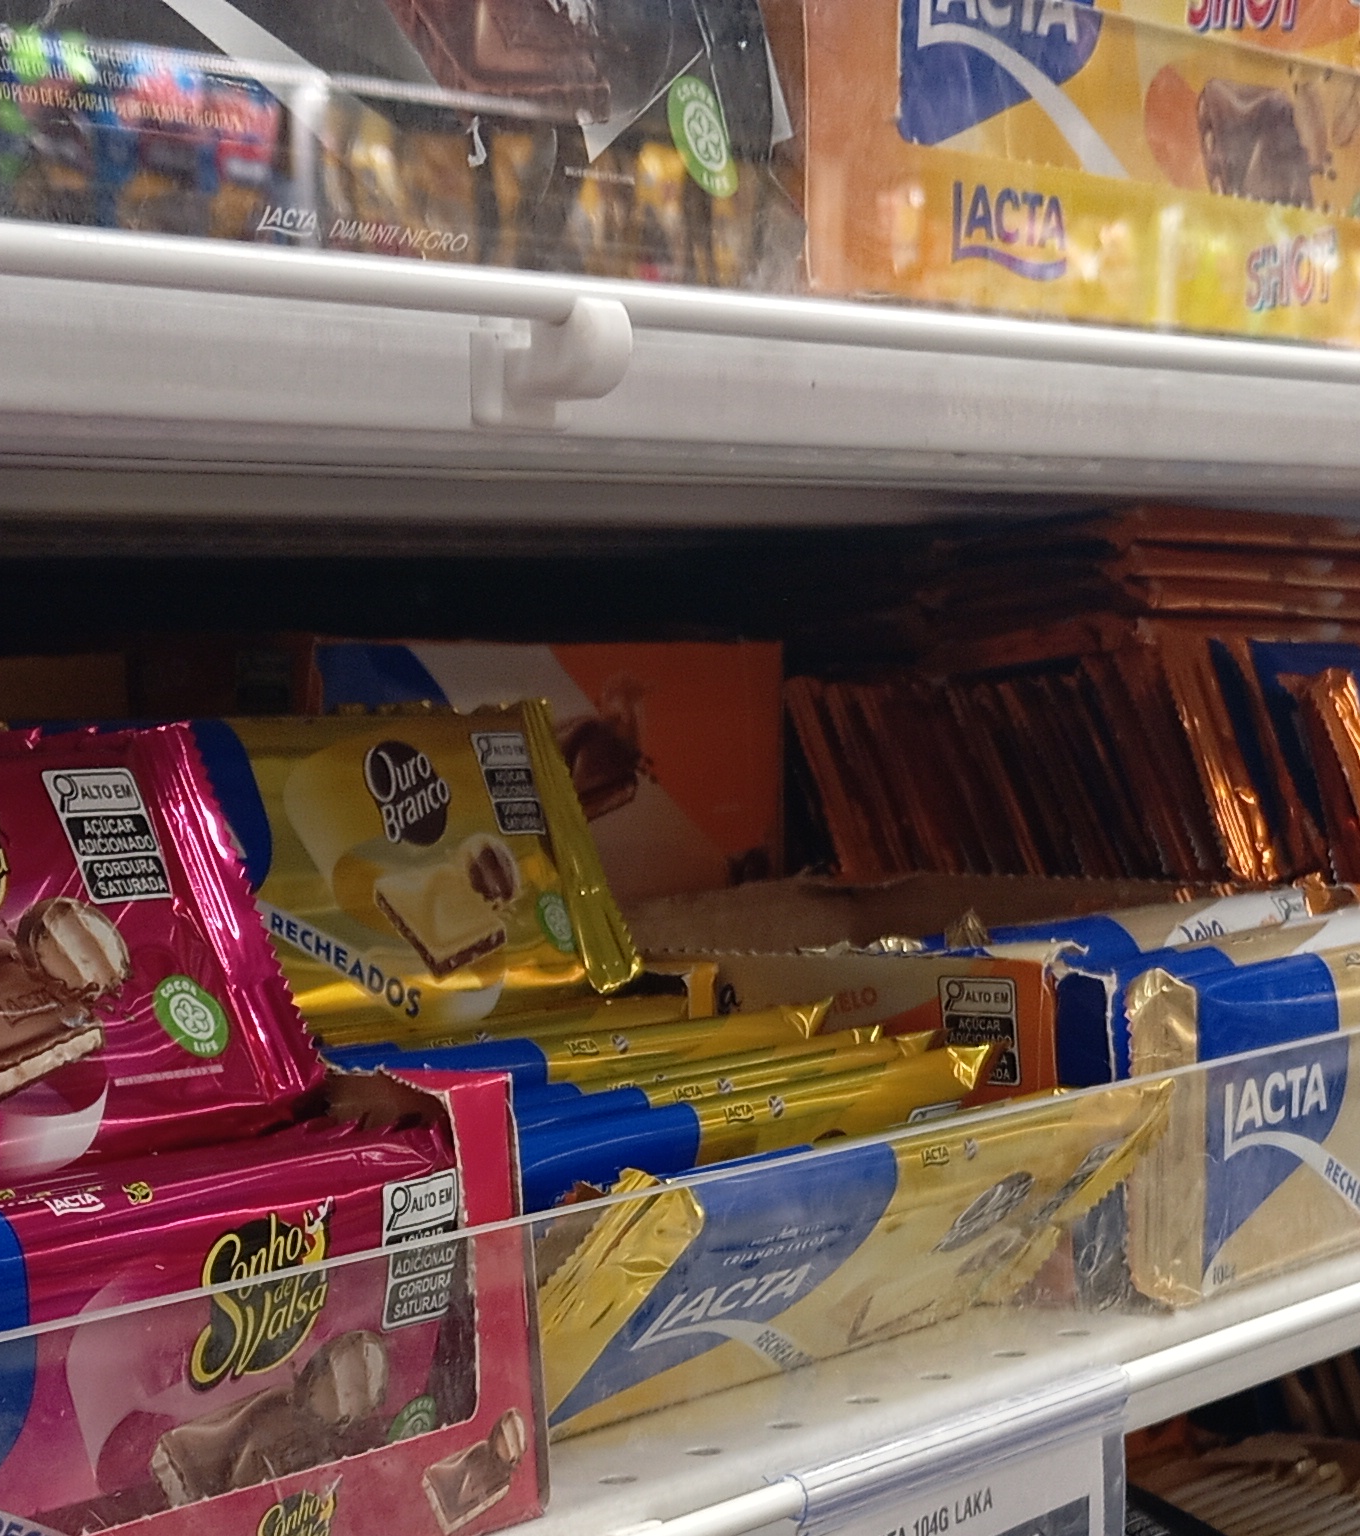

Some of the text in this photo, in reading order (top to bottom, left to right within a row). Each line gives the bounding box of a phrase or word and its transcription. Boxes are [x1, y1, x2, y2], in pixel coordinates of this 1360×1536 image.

[257, 204, 319, 238] LACTA
[398, 226, 469, 254] NEGRO
[951, 180, 1067, 281] LACTA
[364, 746, 431, 803] Ouro
[81, 784, 134, 799] ALTO EM
[381, 777, 450, 844] Branco
[83, 817, 137, 839] AÇÚCAR
[78, 835, 154, 855] ADICIONADO
[93, 855, 159, 878] GORDURA
[98, 875, 168, 897] SATURADA
[269, 911, 422, 1018] RECHEADOS
[966, 990, 994, 1005] ALTO
[1224, 1063, 1327, 1161] LACTA
[410, 1192, 437, 1214] ALTO
[955, 1485, 994, 1528] LAKA
